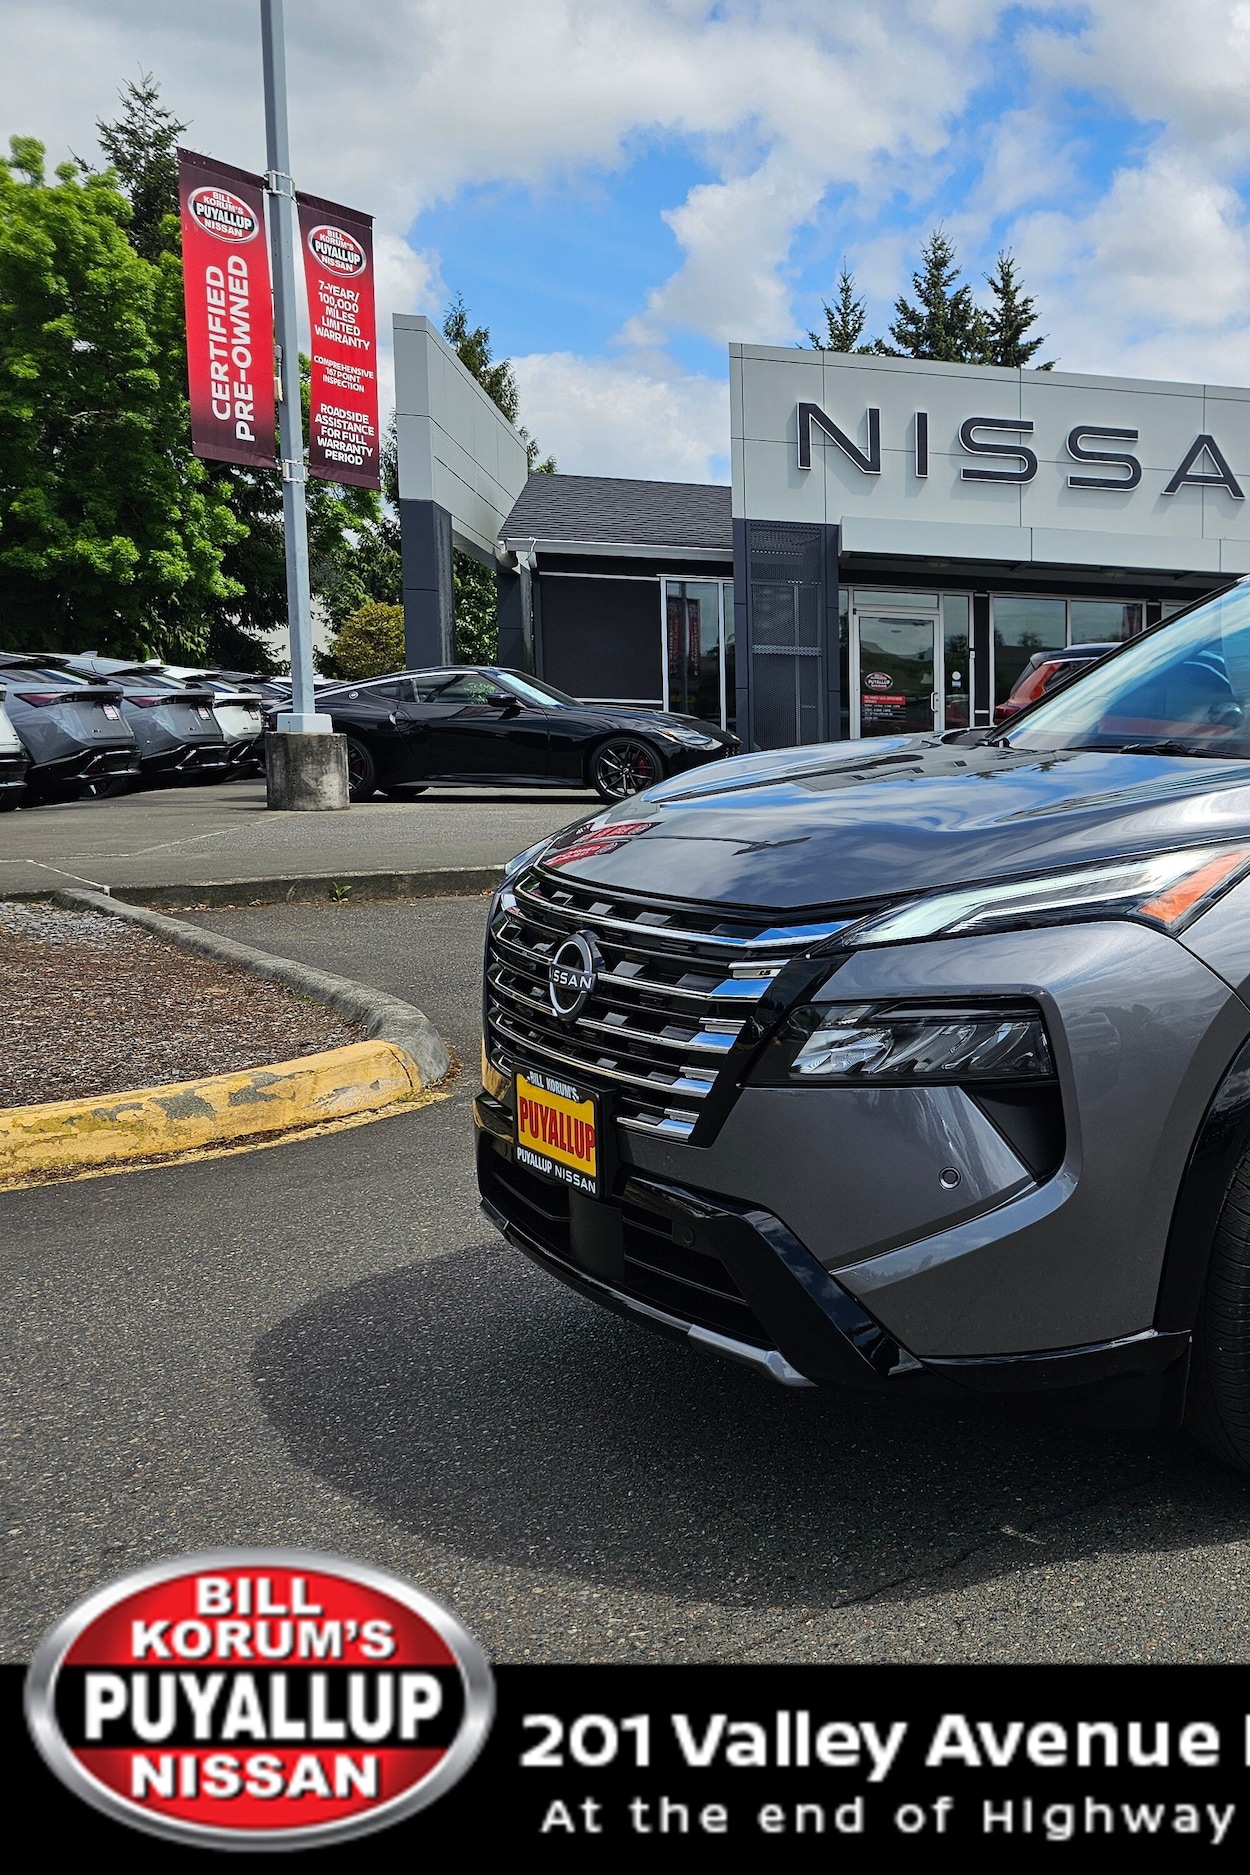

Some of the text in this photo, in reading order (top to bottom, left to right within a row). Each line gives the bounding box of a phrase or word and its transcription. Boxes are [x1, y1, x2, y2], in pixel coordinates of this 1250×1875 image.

[203, 196, 244, 215] KORUM'S
[213, 192, 232, 204] BILL
[196, 203, 252, 230] PUYALLUP
[205, 219, 243, 237] NISSAN
[327, 229, 344, 241] BILL
[315, 240, 361, 265] PUYALLUP
[320, 234, 354, 251] KORUM'S
[321, 255, 353, 272] NISSAN
[319, 280, 360, 303] 7-YEAR/
[319, 292, 359, 314] 100,000
[325, 306, 356, 324] MILES
[314, 324, 370, 351] WARRANTY
[322, 316, 361, 337] LIMITED
[206, 266, 231, 421] CERTIFIED
[227, 255, 256, 442] PRE-OWNED
[313, 355, 374, 379] COMPREHENSIVE
[337, 370, 361, 383] POINT
[322, 374, 365, 393] INSPECTION
[320, 403, 370, 425] ROADSIDE
[315, 414, 375, 437] ASSISTANCE
[321, 426, 367, 446] FOR FULL
[317, 436, 374, 458] WARRANTY
[325, 448, 364, 466] PERIOD
[529, 1071, 580, 1102] BILL KORUM'S
[519, 1096, 596, 1163] PUYALLUP
[516, 1147, 596, 1194] PUYALLUP NISSAN
